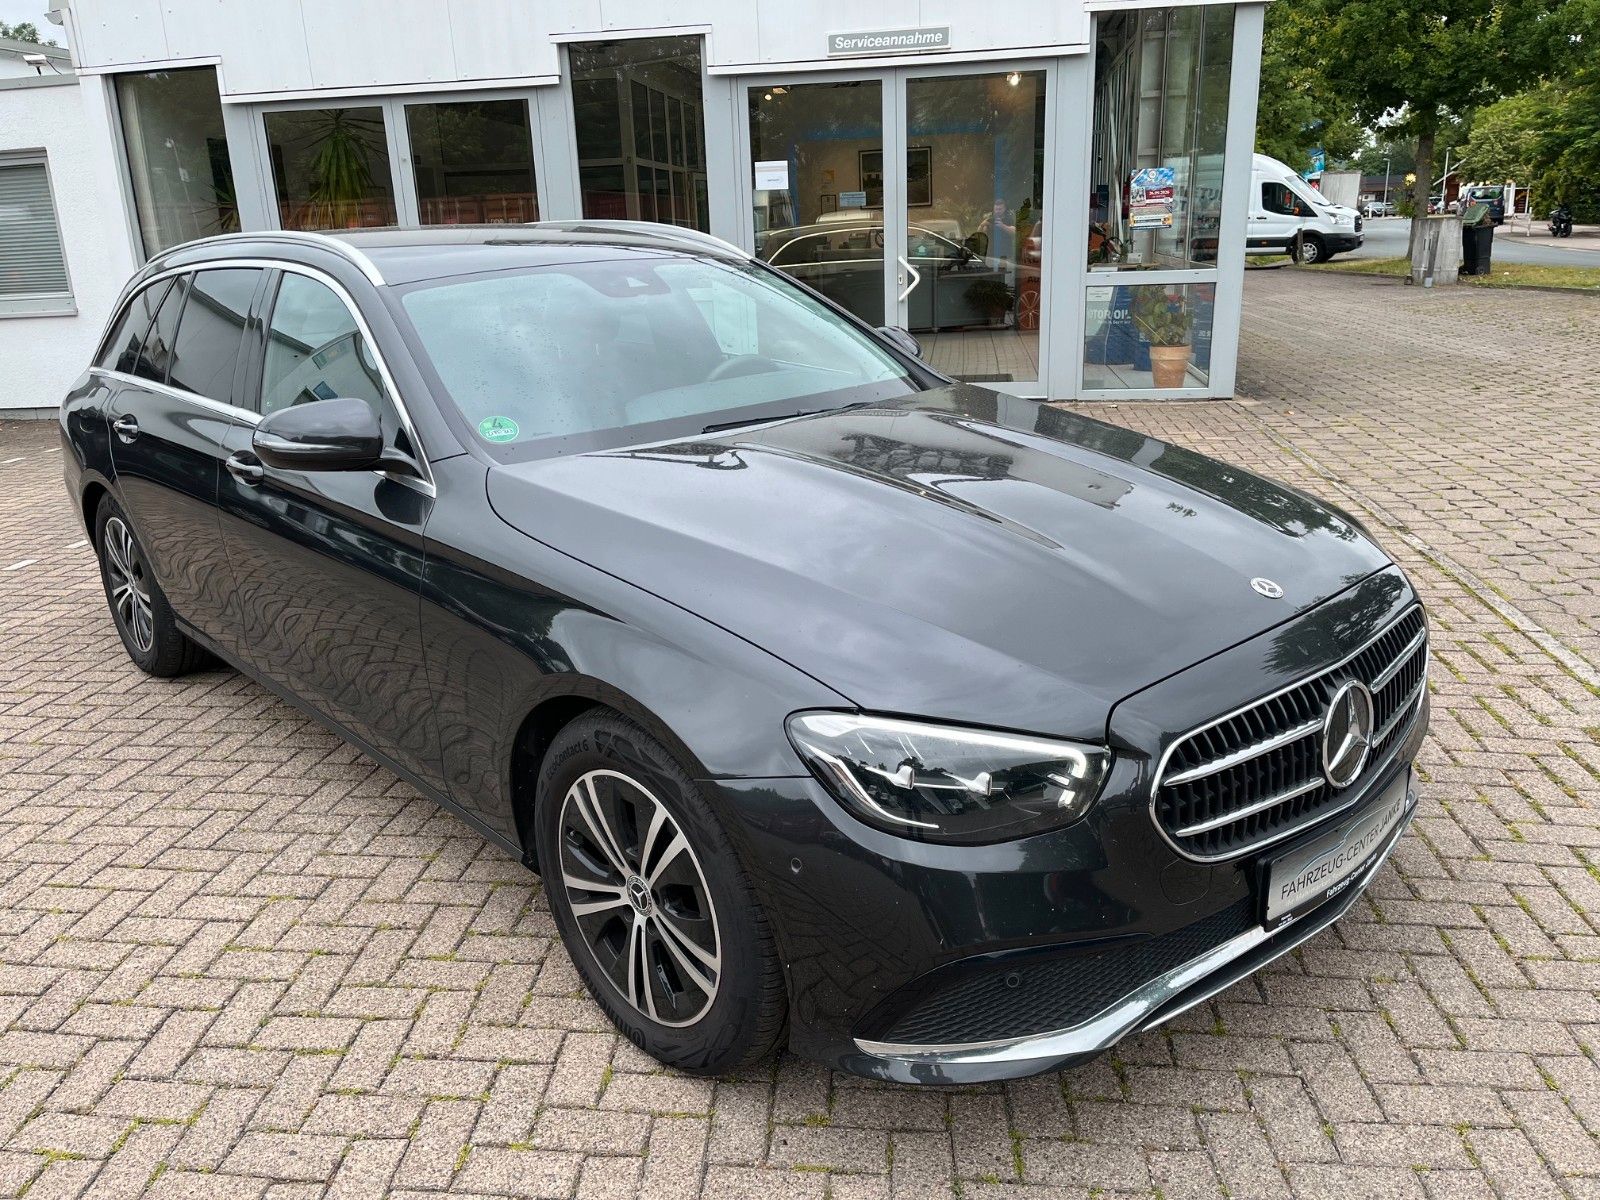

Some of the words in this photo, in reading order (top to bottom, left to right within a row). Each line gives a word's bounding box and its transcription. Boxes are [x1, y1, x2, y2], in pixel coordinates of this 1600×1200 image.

[834, 32, 943, 49] Serviceannahme
[1281, 823, 1379, 900] FAHRZEUG-CENTER
[1379, 797, 1402, 834] JANKE
